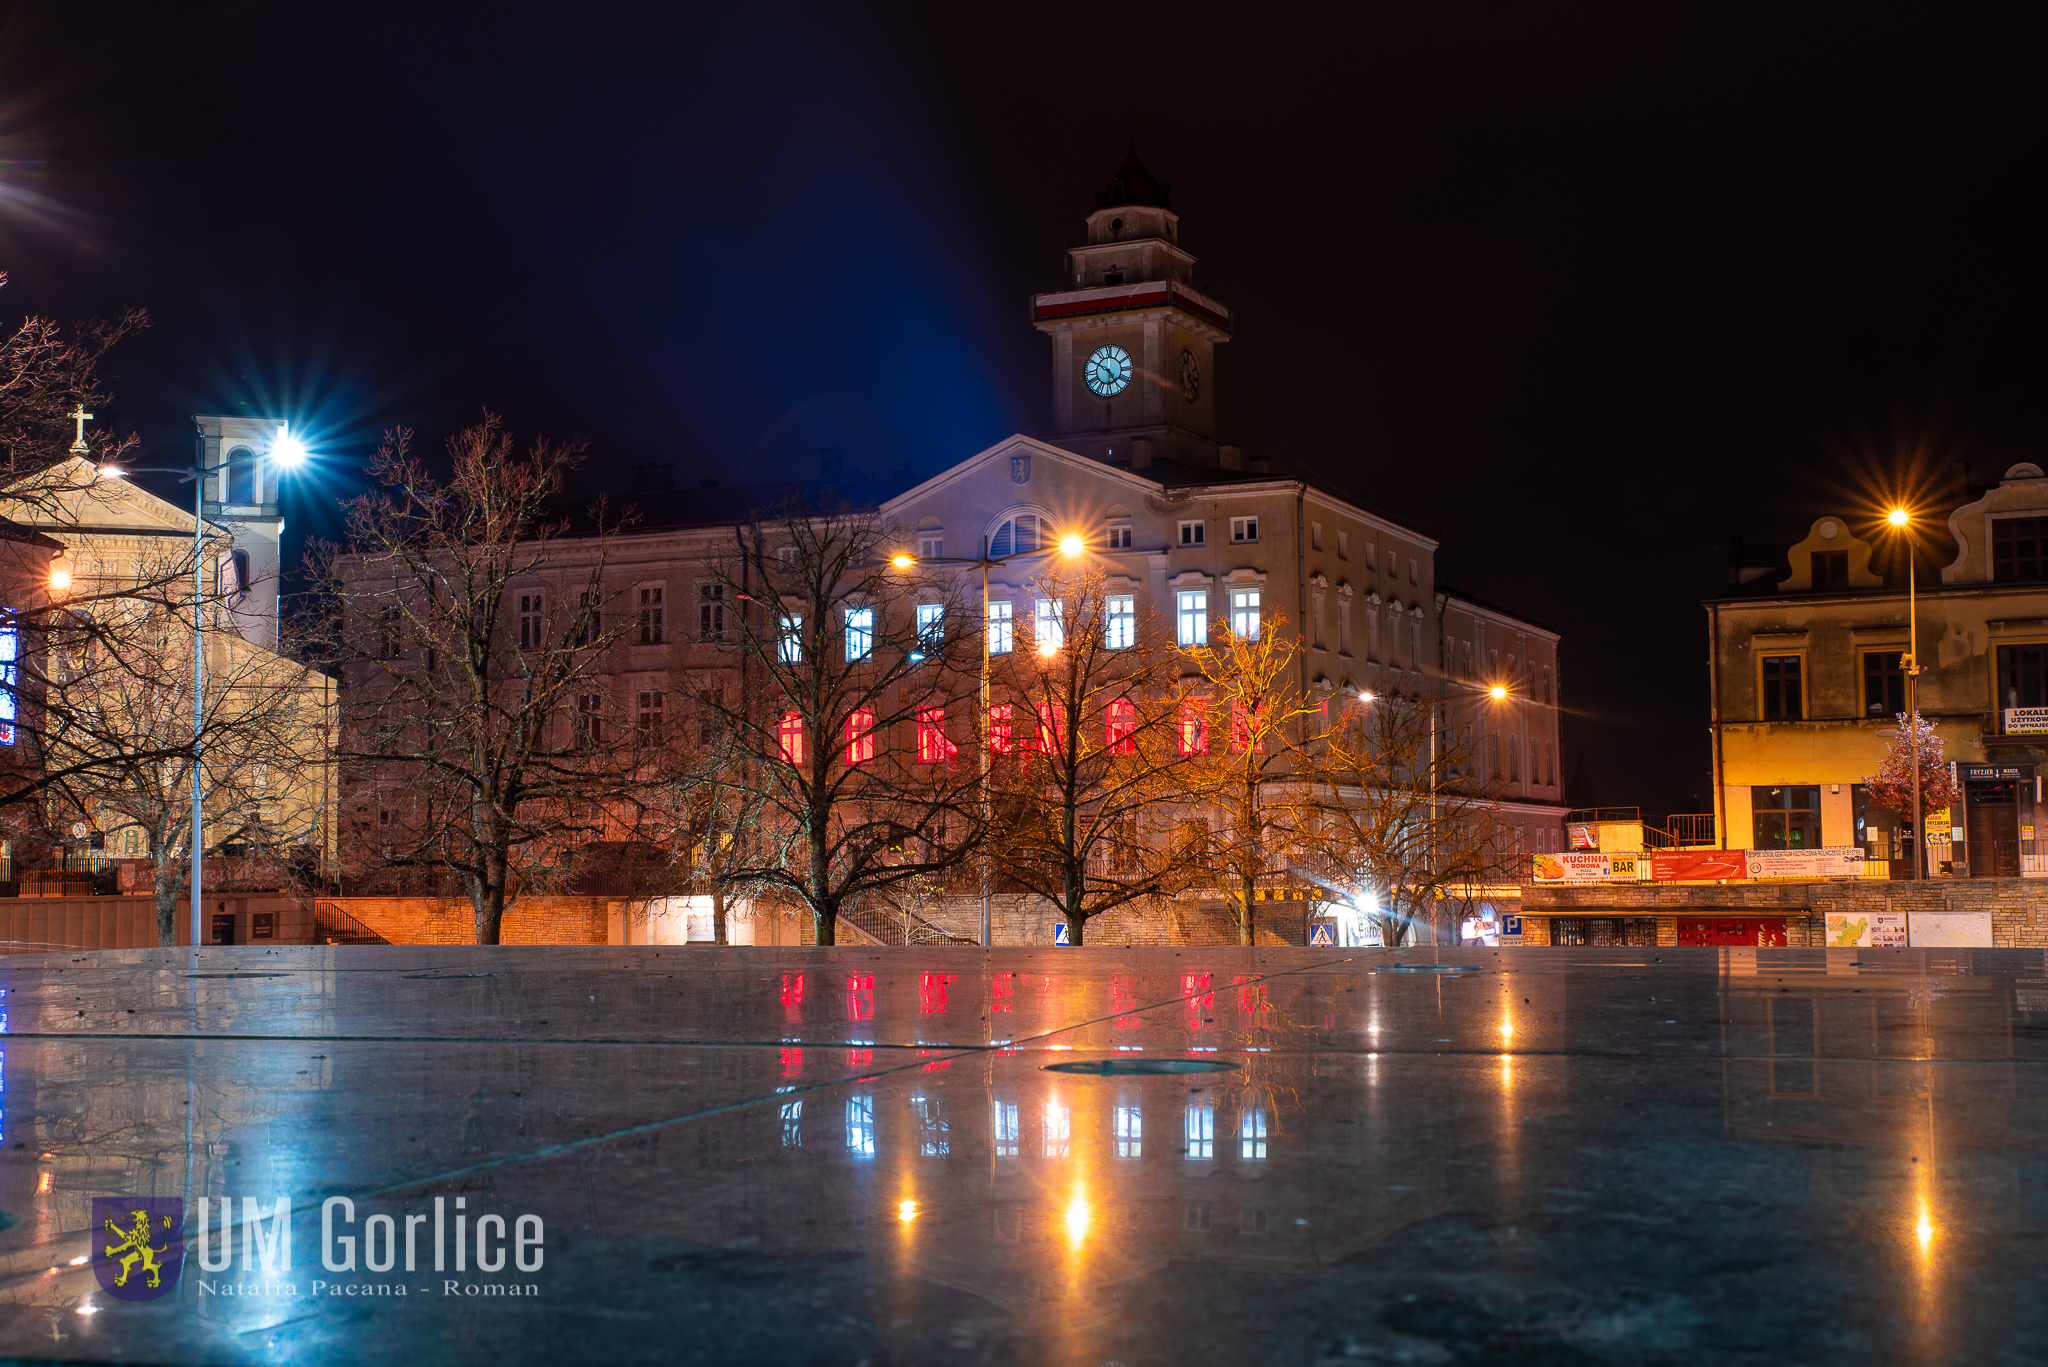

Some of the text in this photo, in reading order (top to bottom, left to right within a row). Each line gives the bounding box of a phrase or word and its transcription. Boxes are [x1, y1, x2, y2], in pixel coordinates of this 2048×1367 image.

[1562, 855, 1609, 864] KUCHNIA
[1613, 861, 1634, 872] BAR
[1507, 917, 1518, 933] P
